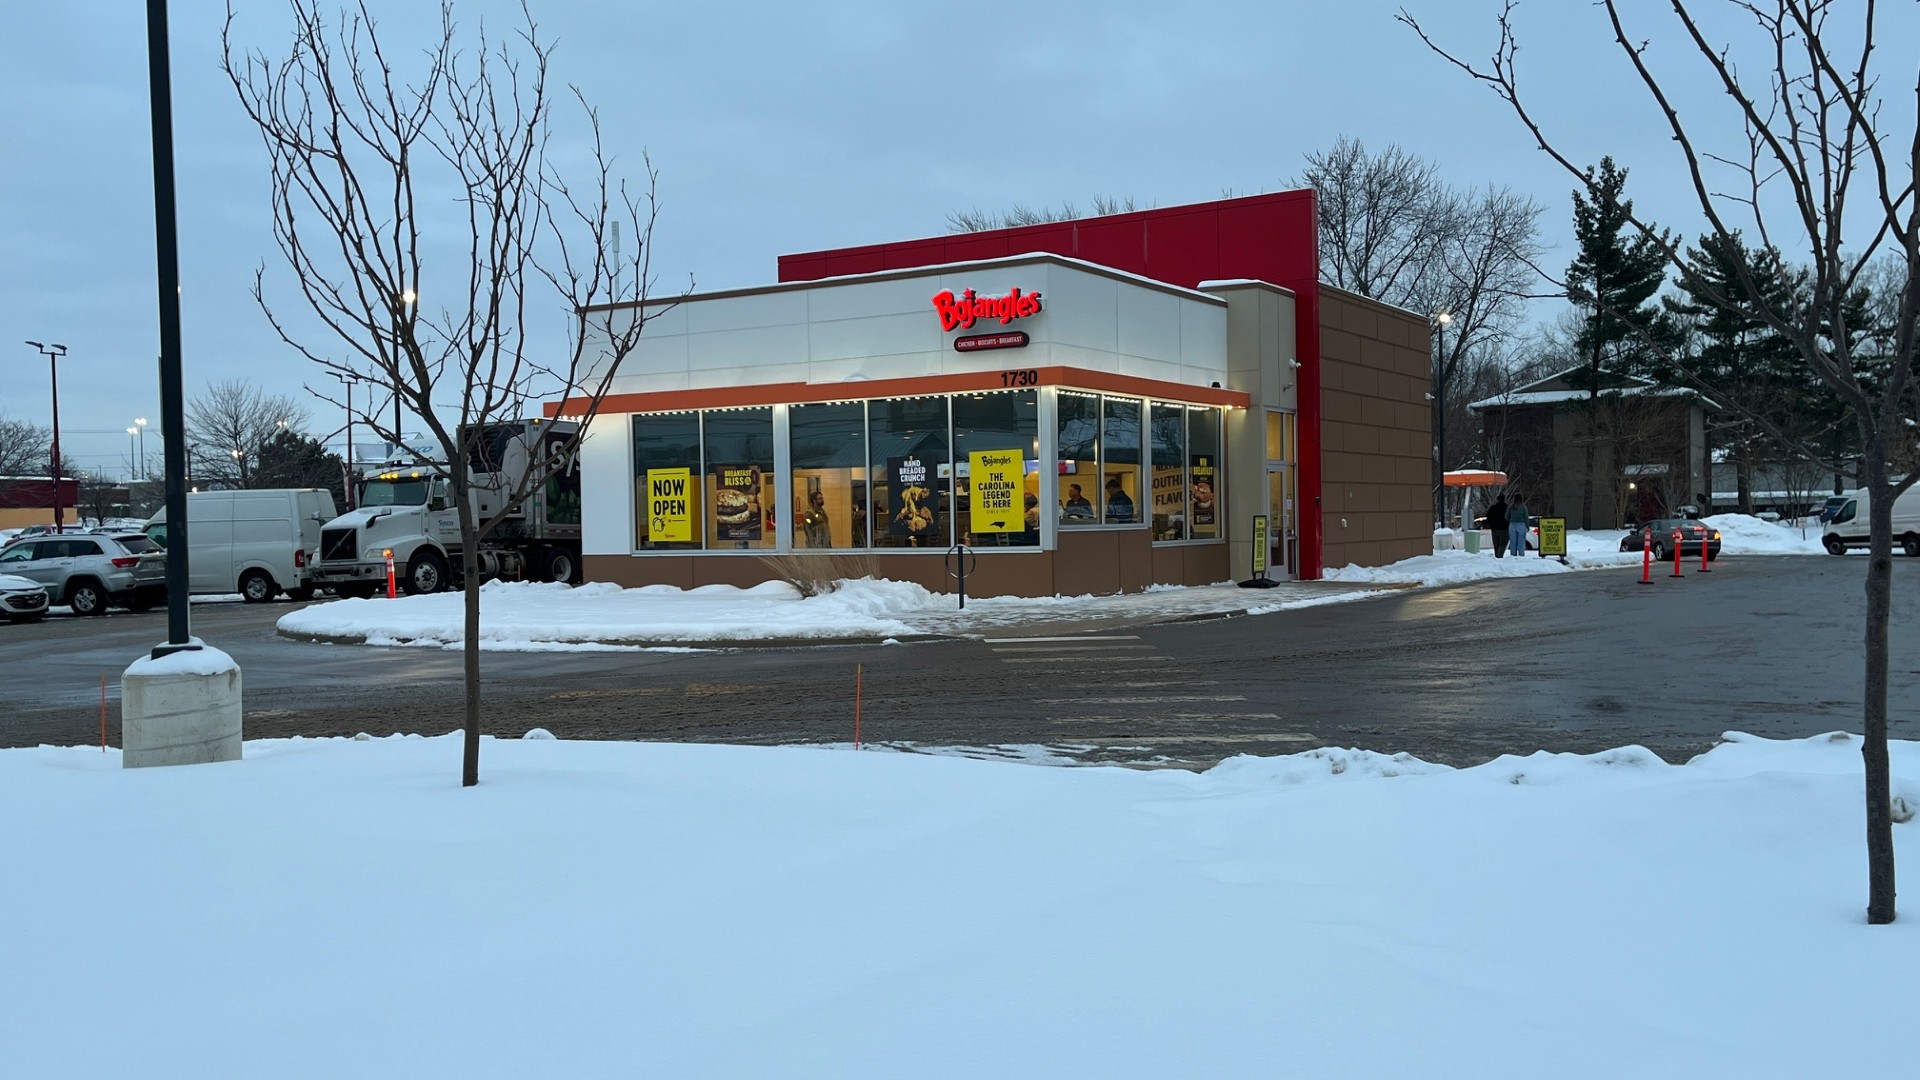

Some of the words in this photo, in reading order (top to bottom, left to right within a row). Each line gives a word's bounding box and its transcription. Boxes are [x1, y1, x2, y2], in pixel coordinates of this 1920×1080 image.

[931, 286, 1042, 332] Bojangles
[957, 340, 975, 348] CHICKEN
[978, 338, 997, 346] BISCUITS
[999, 335, 1022, 344] BREAKFAST
[1001, 369, 1038, 387] 1730
[903, 459, 921, 467] HAND
[981, 455, 1011, 467] Bojangles
[724, 469, 752, 477] BREAKFAST
[899, 466, 926, 475] BREADED
[724, 477, 744, 486] BLISS
[900, 474, 926, 483] CRUNCH
[989, 472, 1004, 482] THE
[653, 479, 685, 497] NOW
[978, 481, 1015, 491] CAROLINA
[983, 490, 1011, 500] LEGEND
[653, 499, 685, 516] OPEN
[983, 500, 991, 509] IS
[992, 499, 1011, 509] HERE
[438, 519, 454, 527] Sysco
